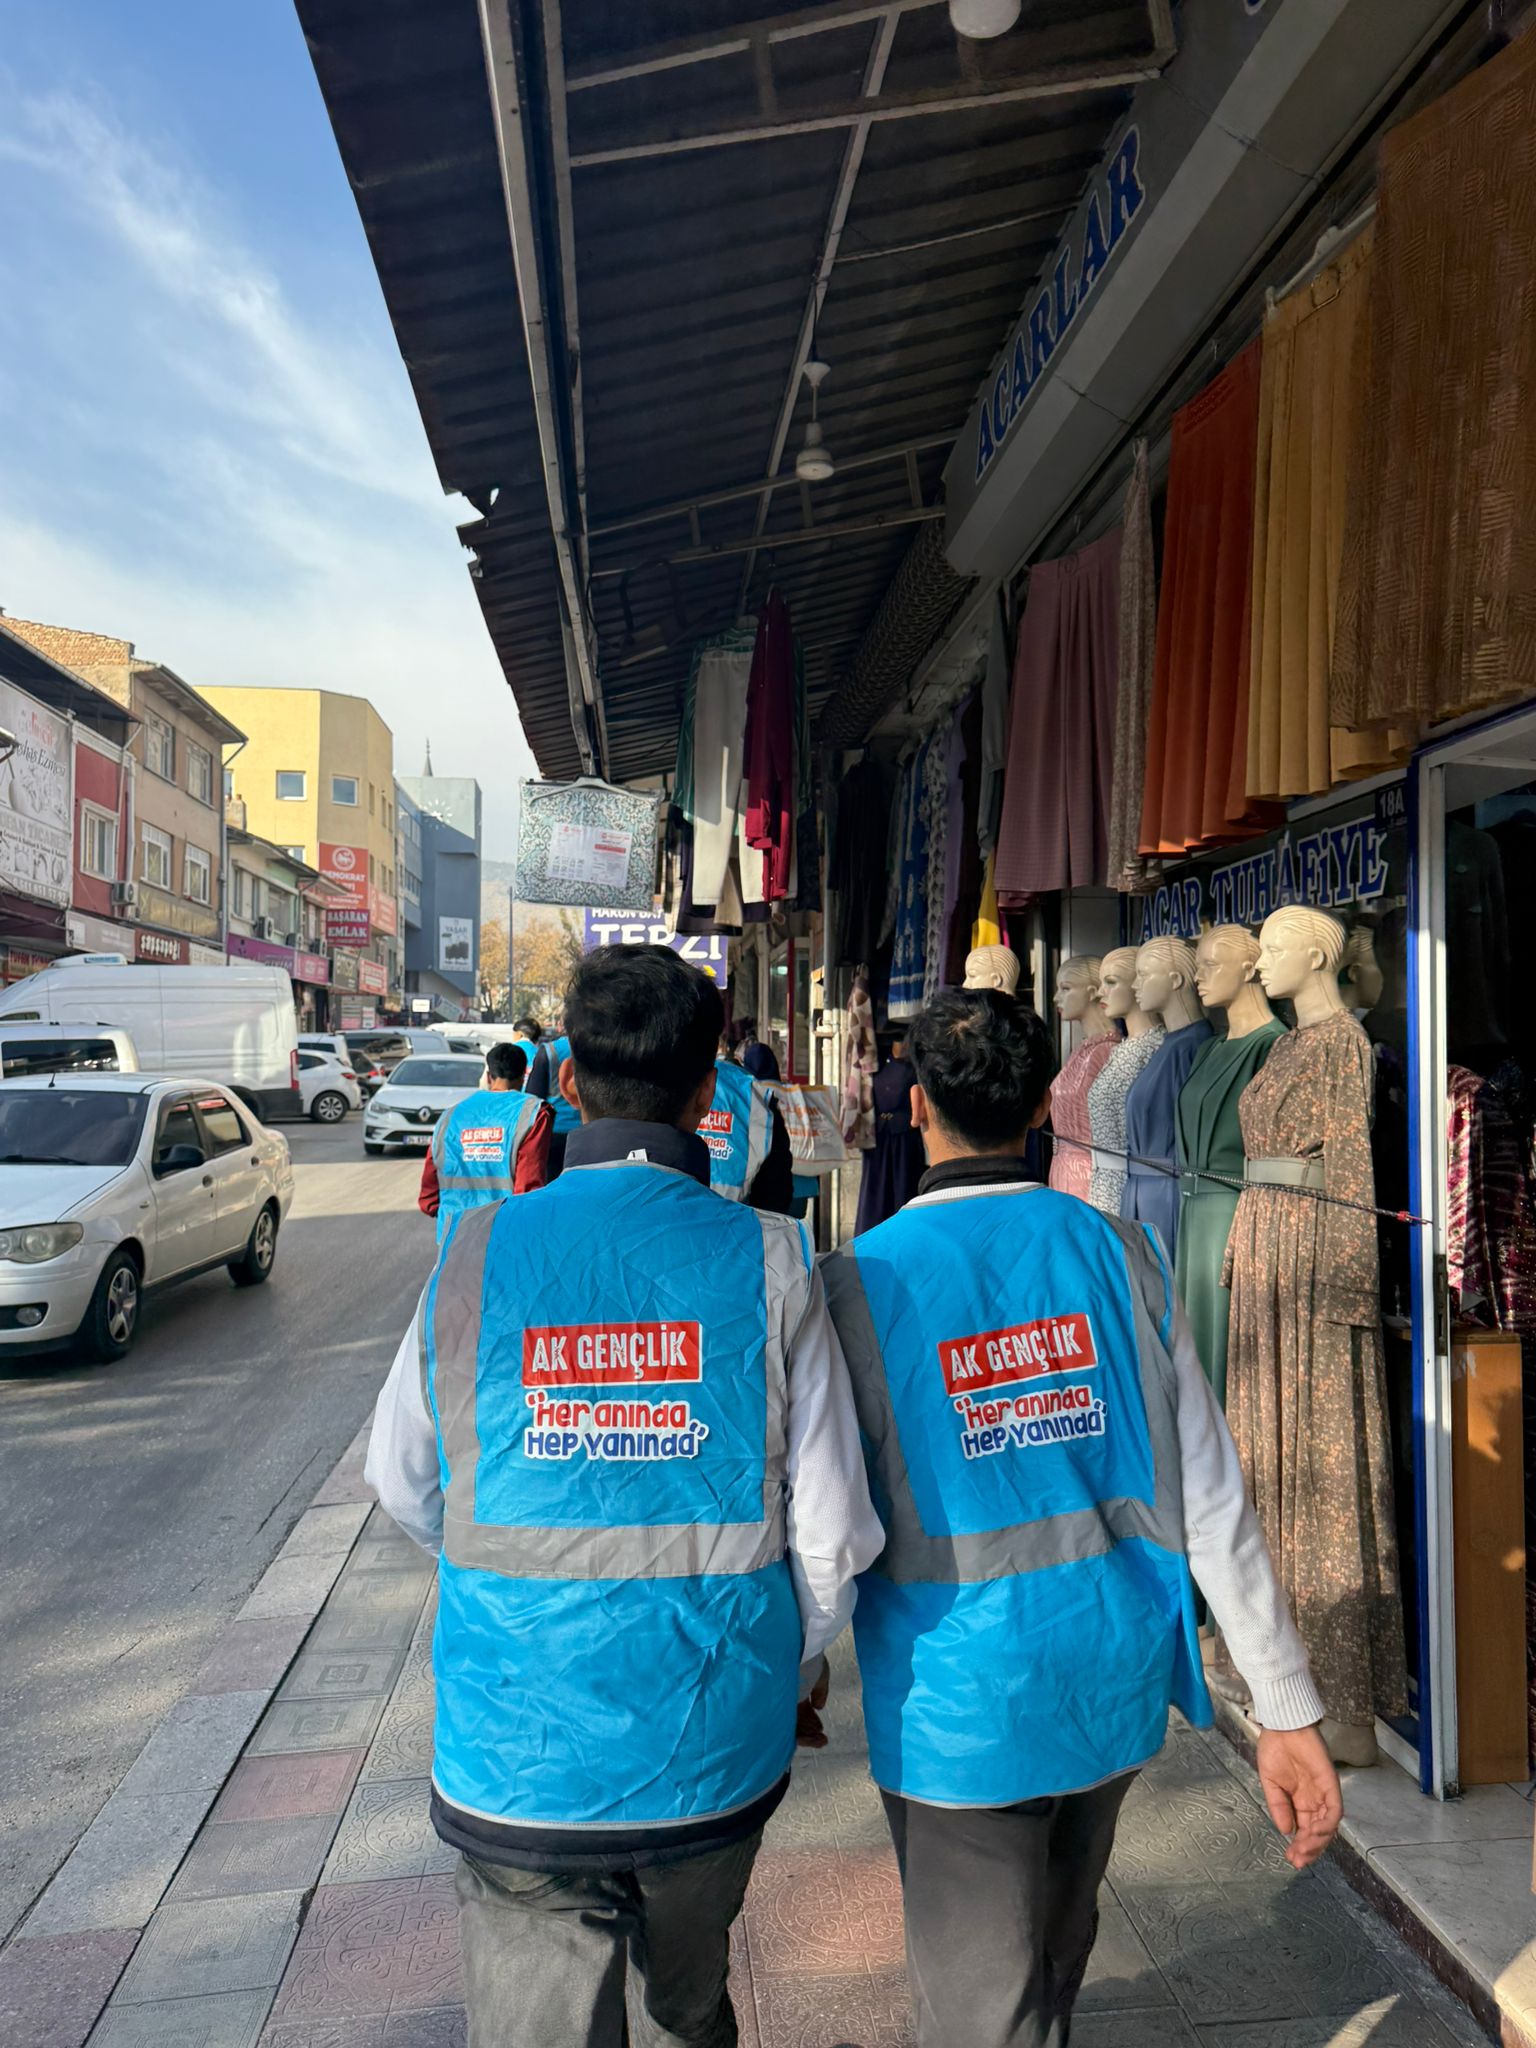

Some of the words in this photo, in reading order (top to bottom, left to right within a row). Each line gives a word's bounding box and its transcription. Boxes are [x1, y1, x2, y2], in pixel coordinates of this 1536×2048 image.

[975, 124, 1146, 486] ACARLAR
[1379, 788, 1405, 819] 18A
[1139, 876, 1205, 944] ACAR
[328, 926, 368, 938] EMLAK
[532, 1335, 568, 1373] AK
[577, 1324, 688, 1379] GENÇLİK
[950, 1343, 984, 1382] AK
[986, 1319, 1083, 1372] GENÇLİK
[594, 1403, 687, 1428] anında
[1014, 1386, 1091, 1418] anında
